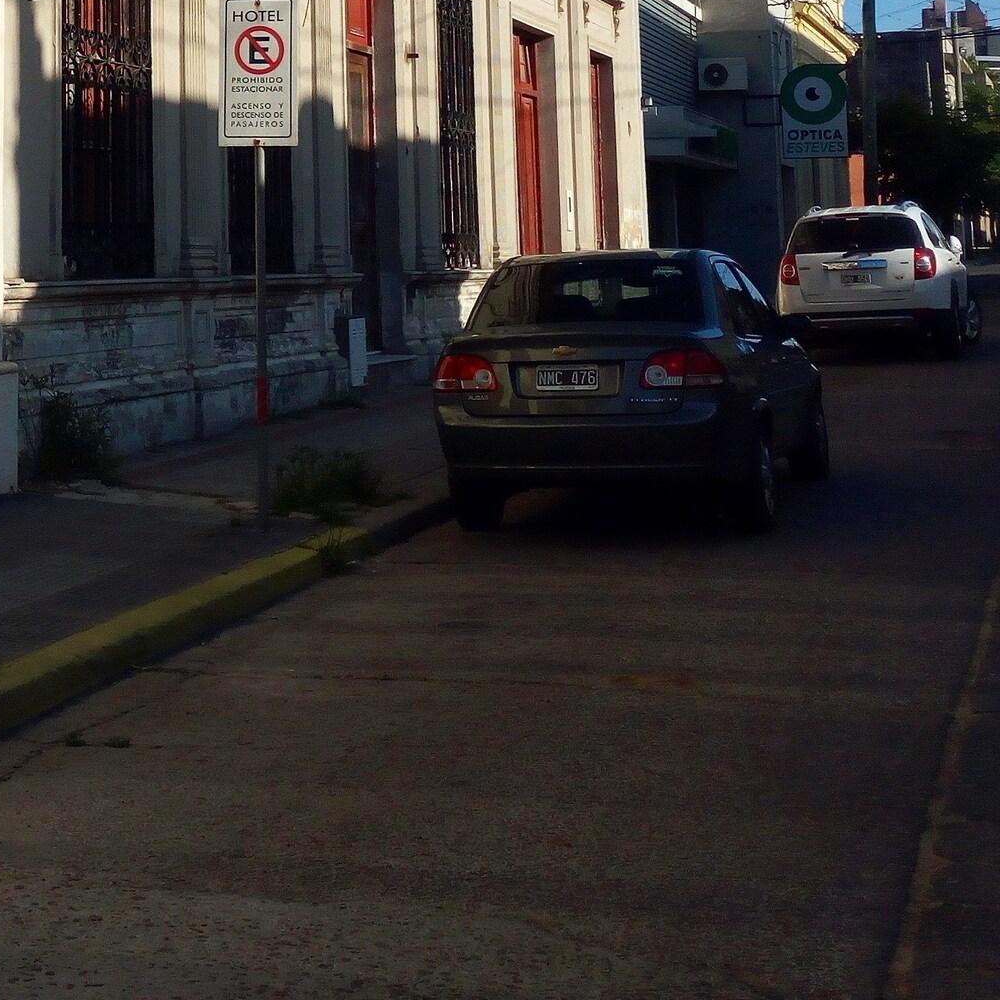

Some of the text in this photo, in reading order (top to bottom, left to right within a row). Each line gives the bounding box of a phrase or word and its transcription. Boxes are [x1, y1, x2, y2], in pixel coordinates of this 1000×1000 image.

[232, 10, 284, 22] HOTEL
[249, 36, 270, 64] E
[231, 120, 284, 128] PASAJEROS
[787, 129, 843, 140] OPTICA
[787, 141, 845, 153] ESTEVES
[571, 371, 596, 385] 476
